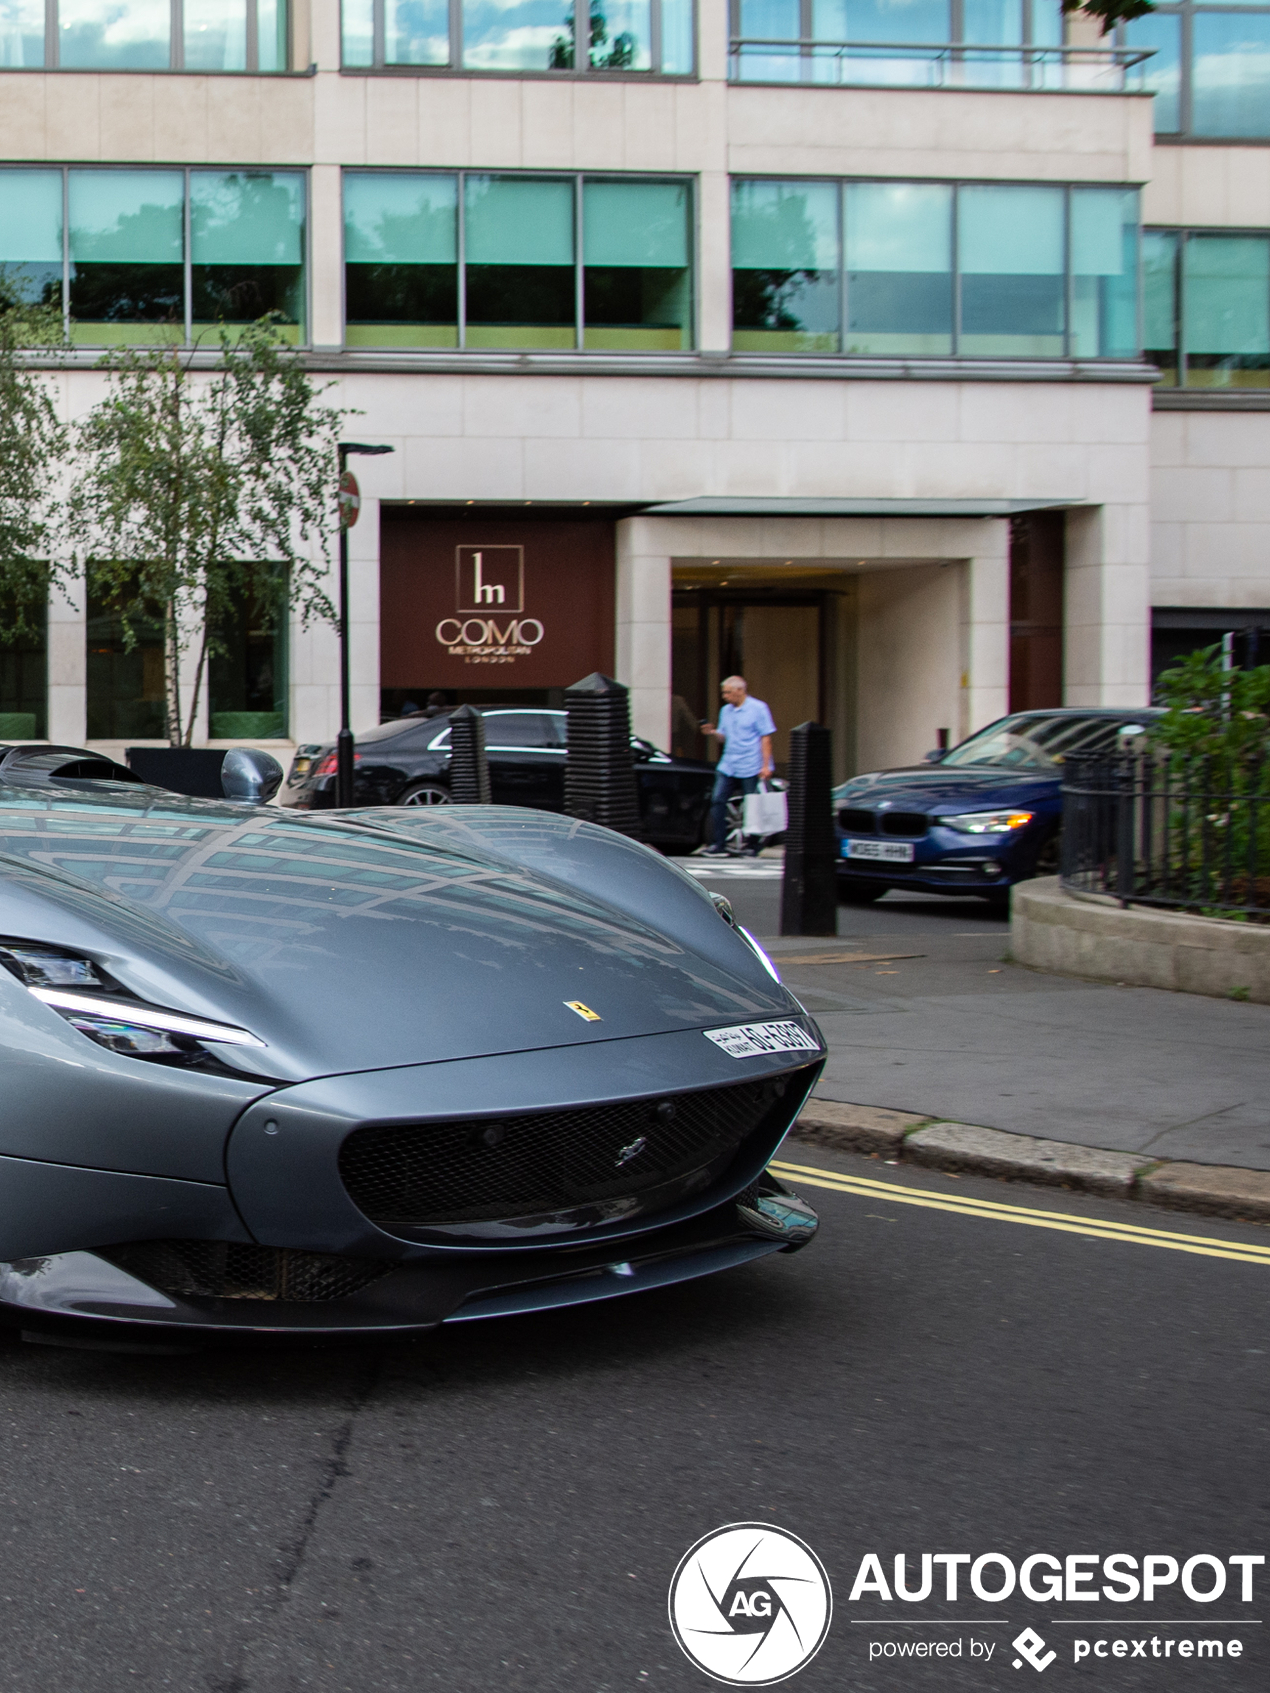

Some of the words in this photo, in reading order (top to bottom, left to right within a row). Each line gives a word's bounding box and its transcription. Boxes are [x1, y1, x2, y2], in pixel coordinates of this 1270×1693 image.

[435, 618, 545, 646] COMO
[723, 1041, 756, 1055] KUWAIT
[739, 1023, 816, 1051] 60-63897
